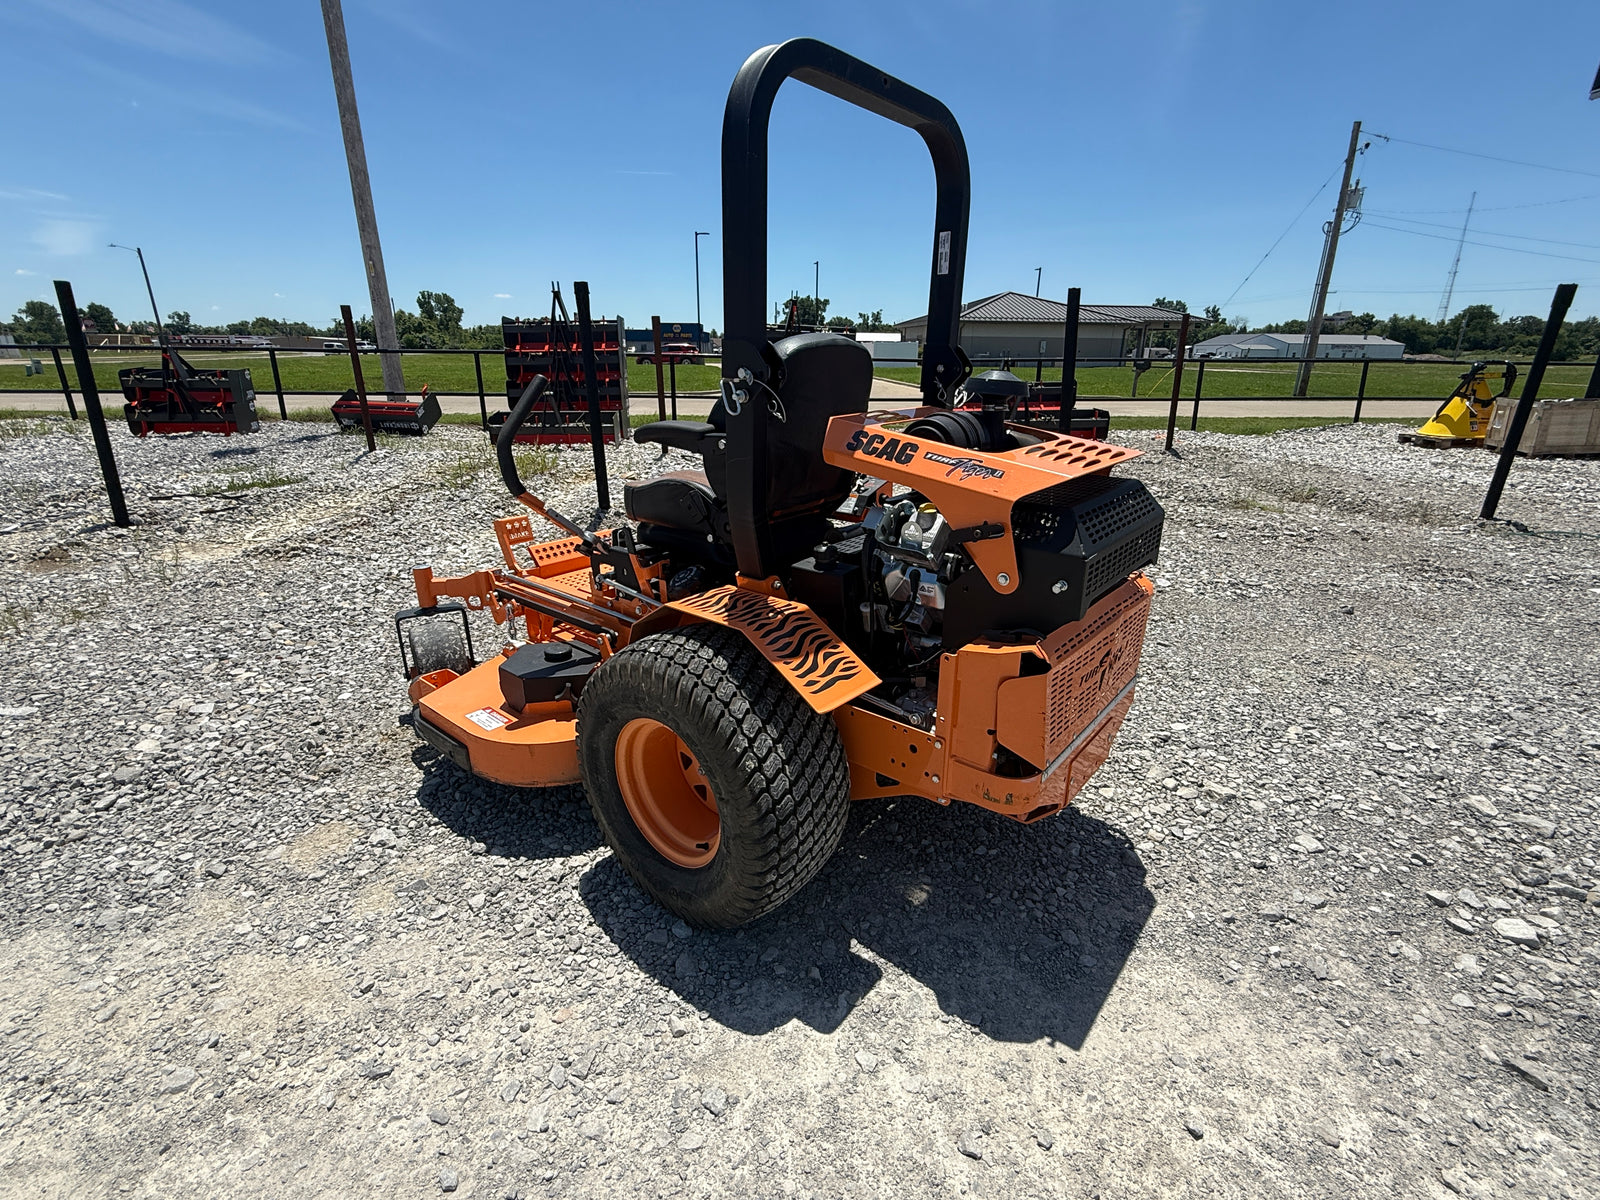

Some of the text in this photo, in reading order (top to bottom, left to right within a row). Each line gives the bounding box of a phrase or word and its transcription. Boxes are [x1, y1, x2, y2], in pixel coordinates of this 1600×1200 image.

[846, 430, 920, 465] SCAG
[925, 452, 959, 465] TURF
[945, 457, 992, 481] Tiger
